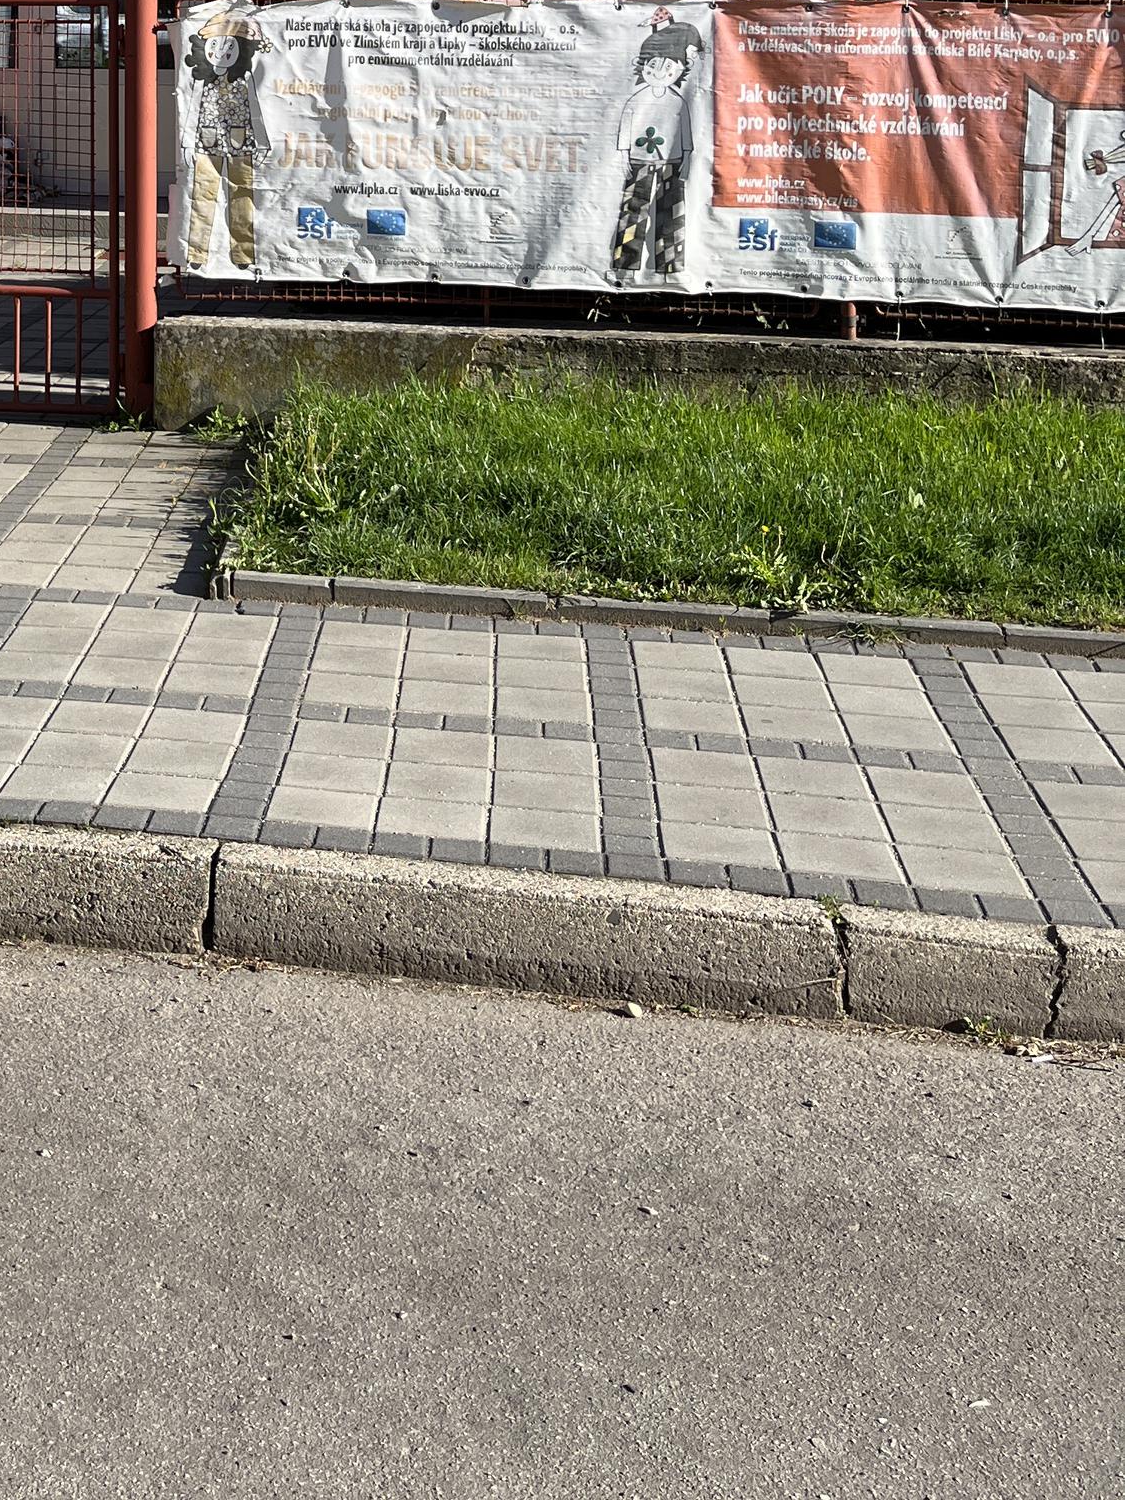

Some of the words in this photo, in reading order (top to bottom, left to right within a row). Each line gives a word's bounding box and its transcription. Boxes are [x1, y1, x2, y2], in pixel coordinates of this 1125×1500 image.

[285, 17, 311, 32] Naše
[363, 18, 391, 32] škola
[392, 20, 403, 36] je
[405, 20, 453, 37] zapojena
[455, 20, 469, 34] do
[472, 21, 517, 37] projektu
[559, 24, 580, 35] o.s.
[739, 21, 767, 36] Naše
[769, 21, 822, 37] mateřská
[825, 21, 856, 37] škola
[857, 23, 868, 40] je
[925, 25, 939, 39] do
[942, 26, 991, 44] projektu
[1062, 31, 1083, 46] pro
[1086, 28, 1120, 44] EVVO
[288, 38, 306, 51] pro
[308, 34, 337, 48] EVVO
[353, 34, 401, 49] Zlínském
[403, 35, 426, 52] kraji
[429, 40, 436, 49] a
[478, 36, 532, 51] školského
[534, 37, 577, 51] zařízení
[738, 42, 745, 52] a
[748, 38, 822, 53] Vzdělávacího
[824, 44, 832, 53] a
[834, 39, 909, 55] informačního
[968, 43, 992, 58] Bílé
[994, 44, 1044, 62] Karpaty,
[1047, 49, 1080, 63] o.p.s.
[348, 55, 365, 67] pro
[368, 53, 454, 67] environmentální
[457, 53, 514, 67] vzdělávání
[737, 84, 764, 104] Jak
[767, 84, 800, 105] učit
[802, 85, 846, 106] POLY
[862, 88, 911, 111] rozvoj
[914, 90, 1008, 113] kompetencí
[737, 115, 764, 134] pro
[767, 112, 877, 135] polytechnické
[880, 115, 965, 137] vzdělávání
[736, 143, 746, 157] v
[749, 140, 821, 159] mateřské
[824, 140, 871, 161] škole.
[334, 182, 399, 198] www.lipka.cz
[410, 183, 500, 198] www.liska-evvo.cz
[737, 174, 806, 190] www.lipka.cz
